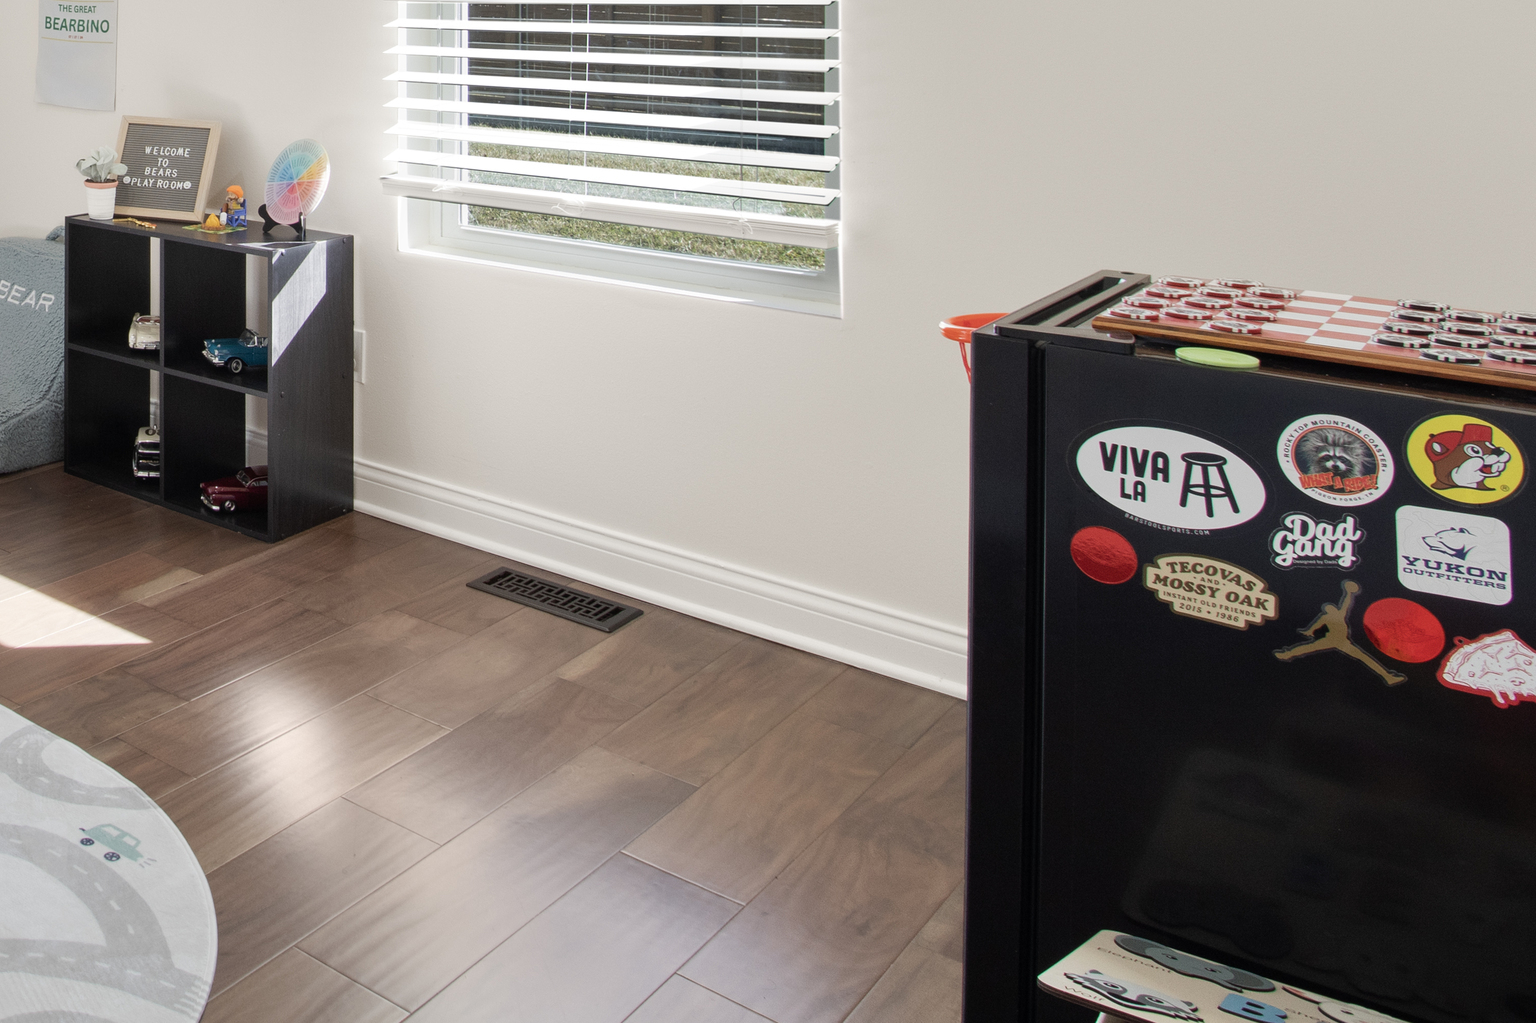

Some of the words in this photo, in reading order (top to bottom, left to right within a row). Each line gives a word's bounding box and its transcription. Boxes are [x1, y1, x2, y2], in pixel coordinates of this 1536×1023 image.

[58, 4, 72, 13] THE
[74, 5, 97, 14] GREAT
[45, 16, 110, 33] BEARBINO
[145, 146, 190, 157] WELCOME
[157, 158, 169, 167] TO
[144, 167, 178, 178] BEARS
[1284, 434, 1295, 458] ROCKY
[1293, 423, 1309, 434] TOP
[1311, 419, 1362, 434] MOUNTAIN
[1363, 434, 1387, 468] COASTER
[1099, 441, 1170, 483] VIVA
[1120, 477, 1146, 503] LA
[1298, 472, 1334, 489] WHAT
[1333, 476, 1344, 489] A
[1310, 488, 1337, 501] PIGEON
[1124, 513, 1211, 535] BARSTOOLSPORTS.COM
[1284, 514, 1362, 541] Dad
[1272, 530, 1357, 568] Gang
[1166, 561, 1256, 592] TECOVAS
[1402, 555, 1507, 582] YUKON
[1402, 567, 1506, 590] OUTFITTERS
[1152, 573, 1221, 598] MOSSY
[1225, 591, 1270, 611] OAK
[1200, 577, 1220, 586] AND
[1162, 590, 1197, 603] INSTANT
[1200, 599, 1217, 608] OLD
[1219, 604, 1257, 618] FRIENDS
[1179, 602, 1203, 614] 2015
[1215, 611, 1240, 623] 1986
[1097, 946, 1173, 974] Elephant
